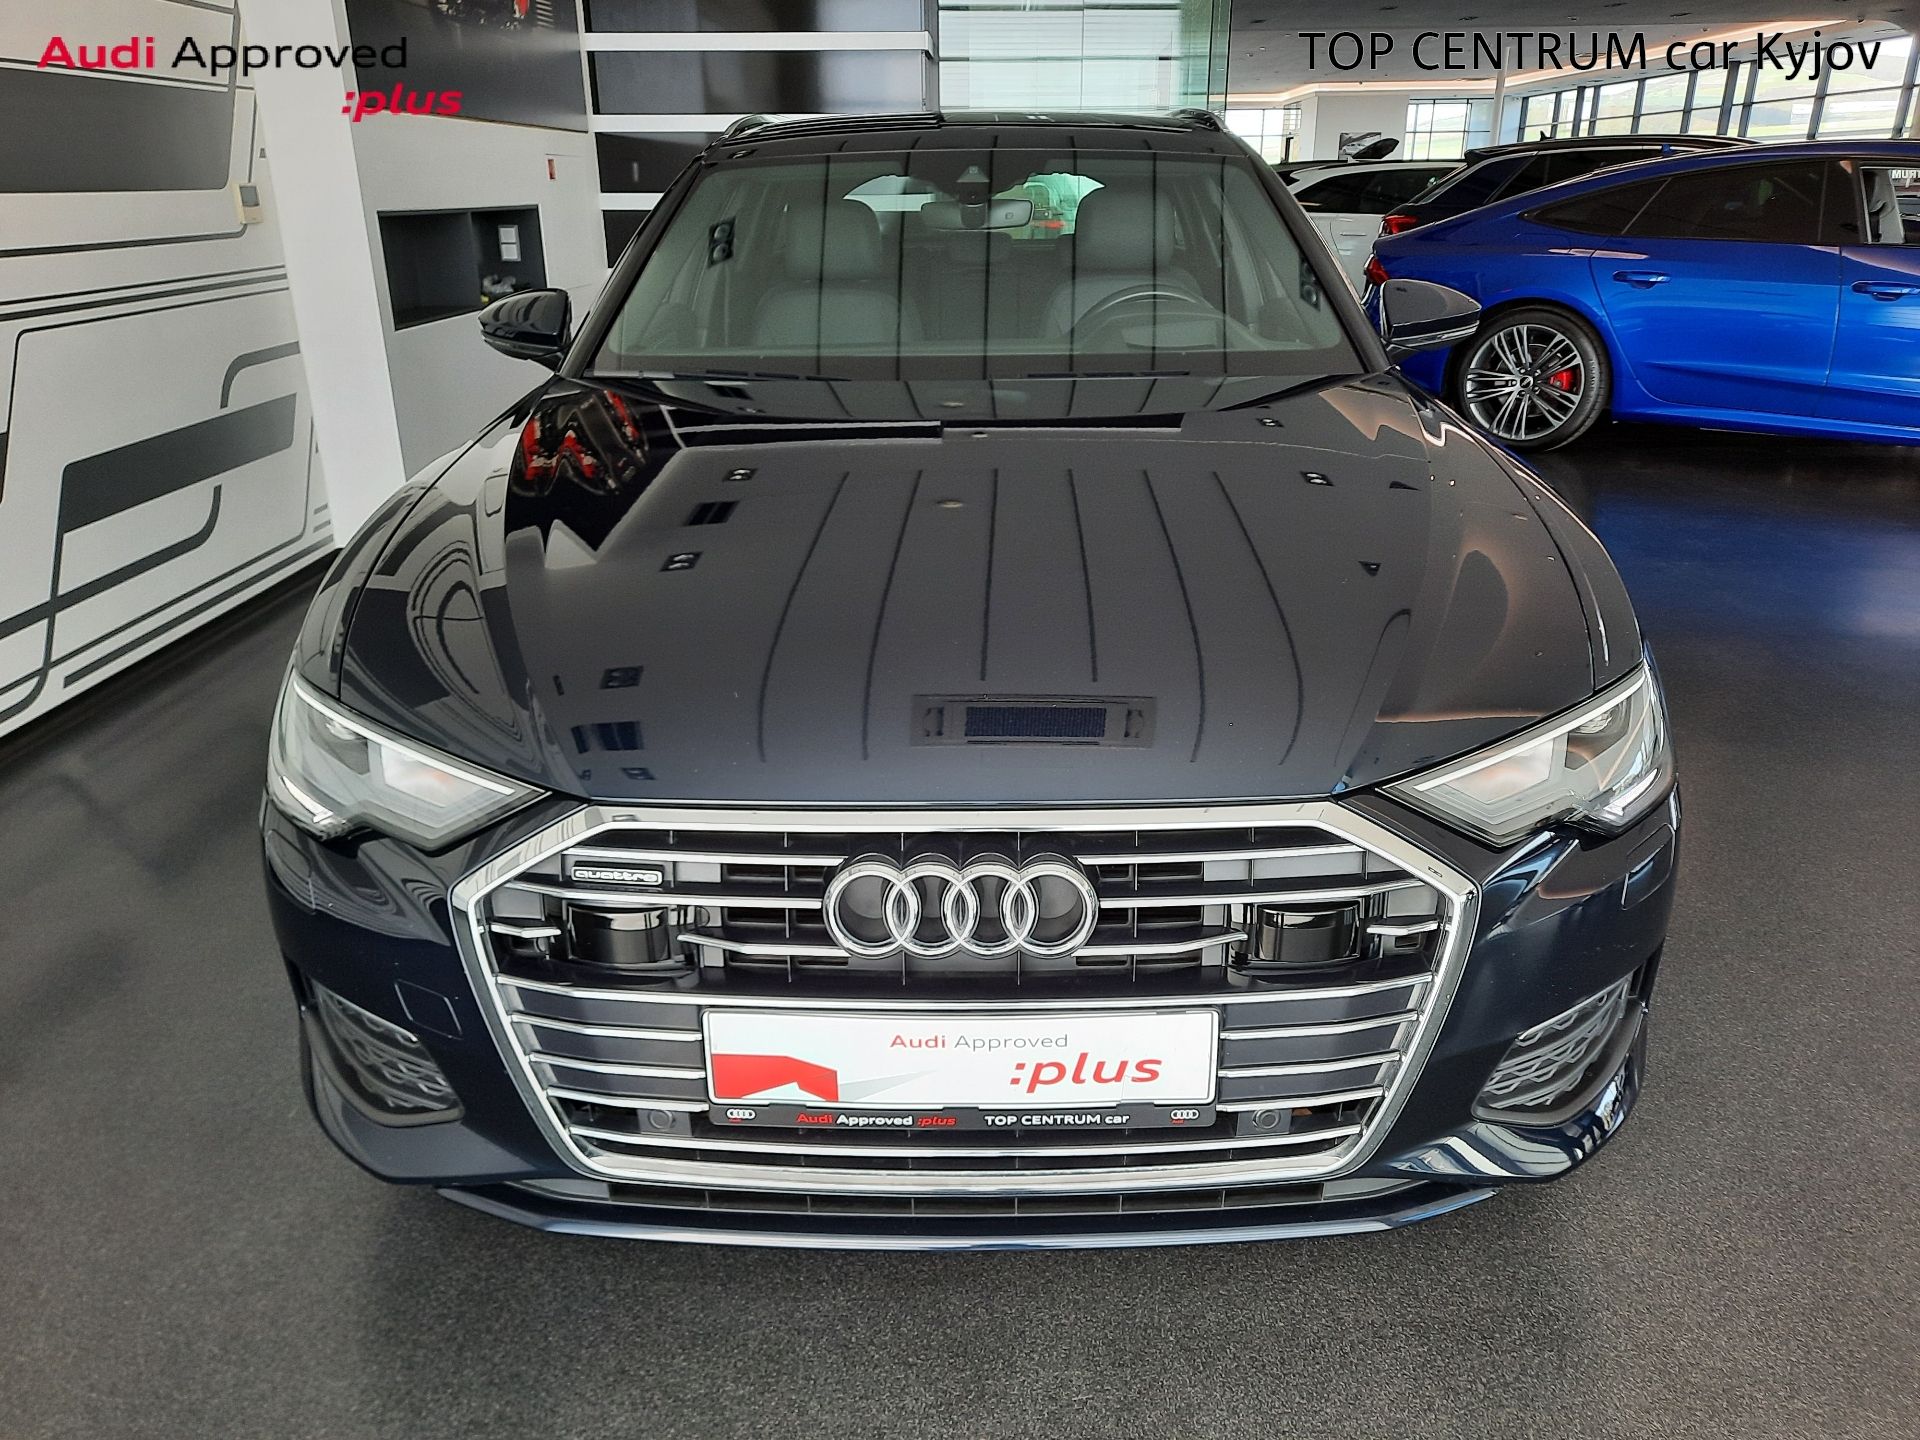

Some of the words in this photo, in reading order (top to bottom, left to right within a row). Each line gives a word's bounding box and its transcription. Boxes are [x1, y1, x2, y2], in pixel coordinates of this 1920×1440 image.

[574, 869, 659, 883] quattro
[890, 1034, 947, 1049] Audi
[953, 1033, 1069, 1052] Approved
[1009, 1051, 1163, 1094] :plus
[797, 1112, 833, 1124] Audi
[836, 1113, 913, 1127] Approved
[984, 1114, 1018, 1126] TOP
[1020, 1114, 1101, 1126] CENTRUM
[1104, 1114, 1130, 1125] car
